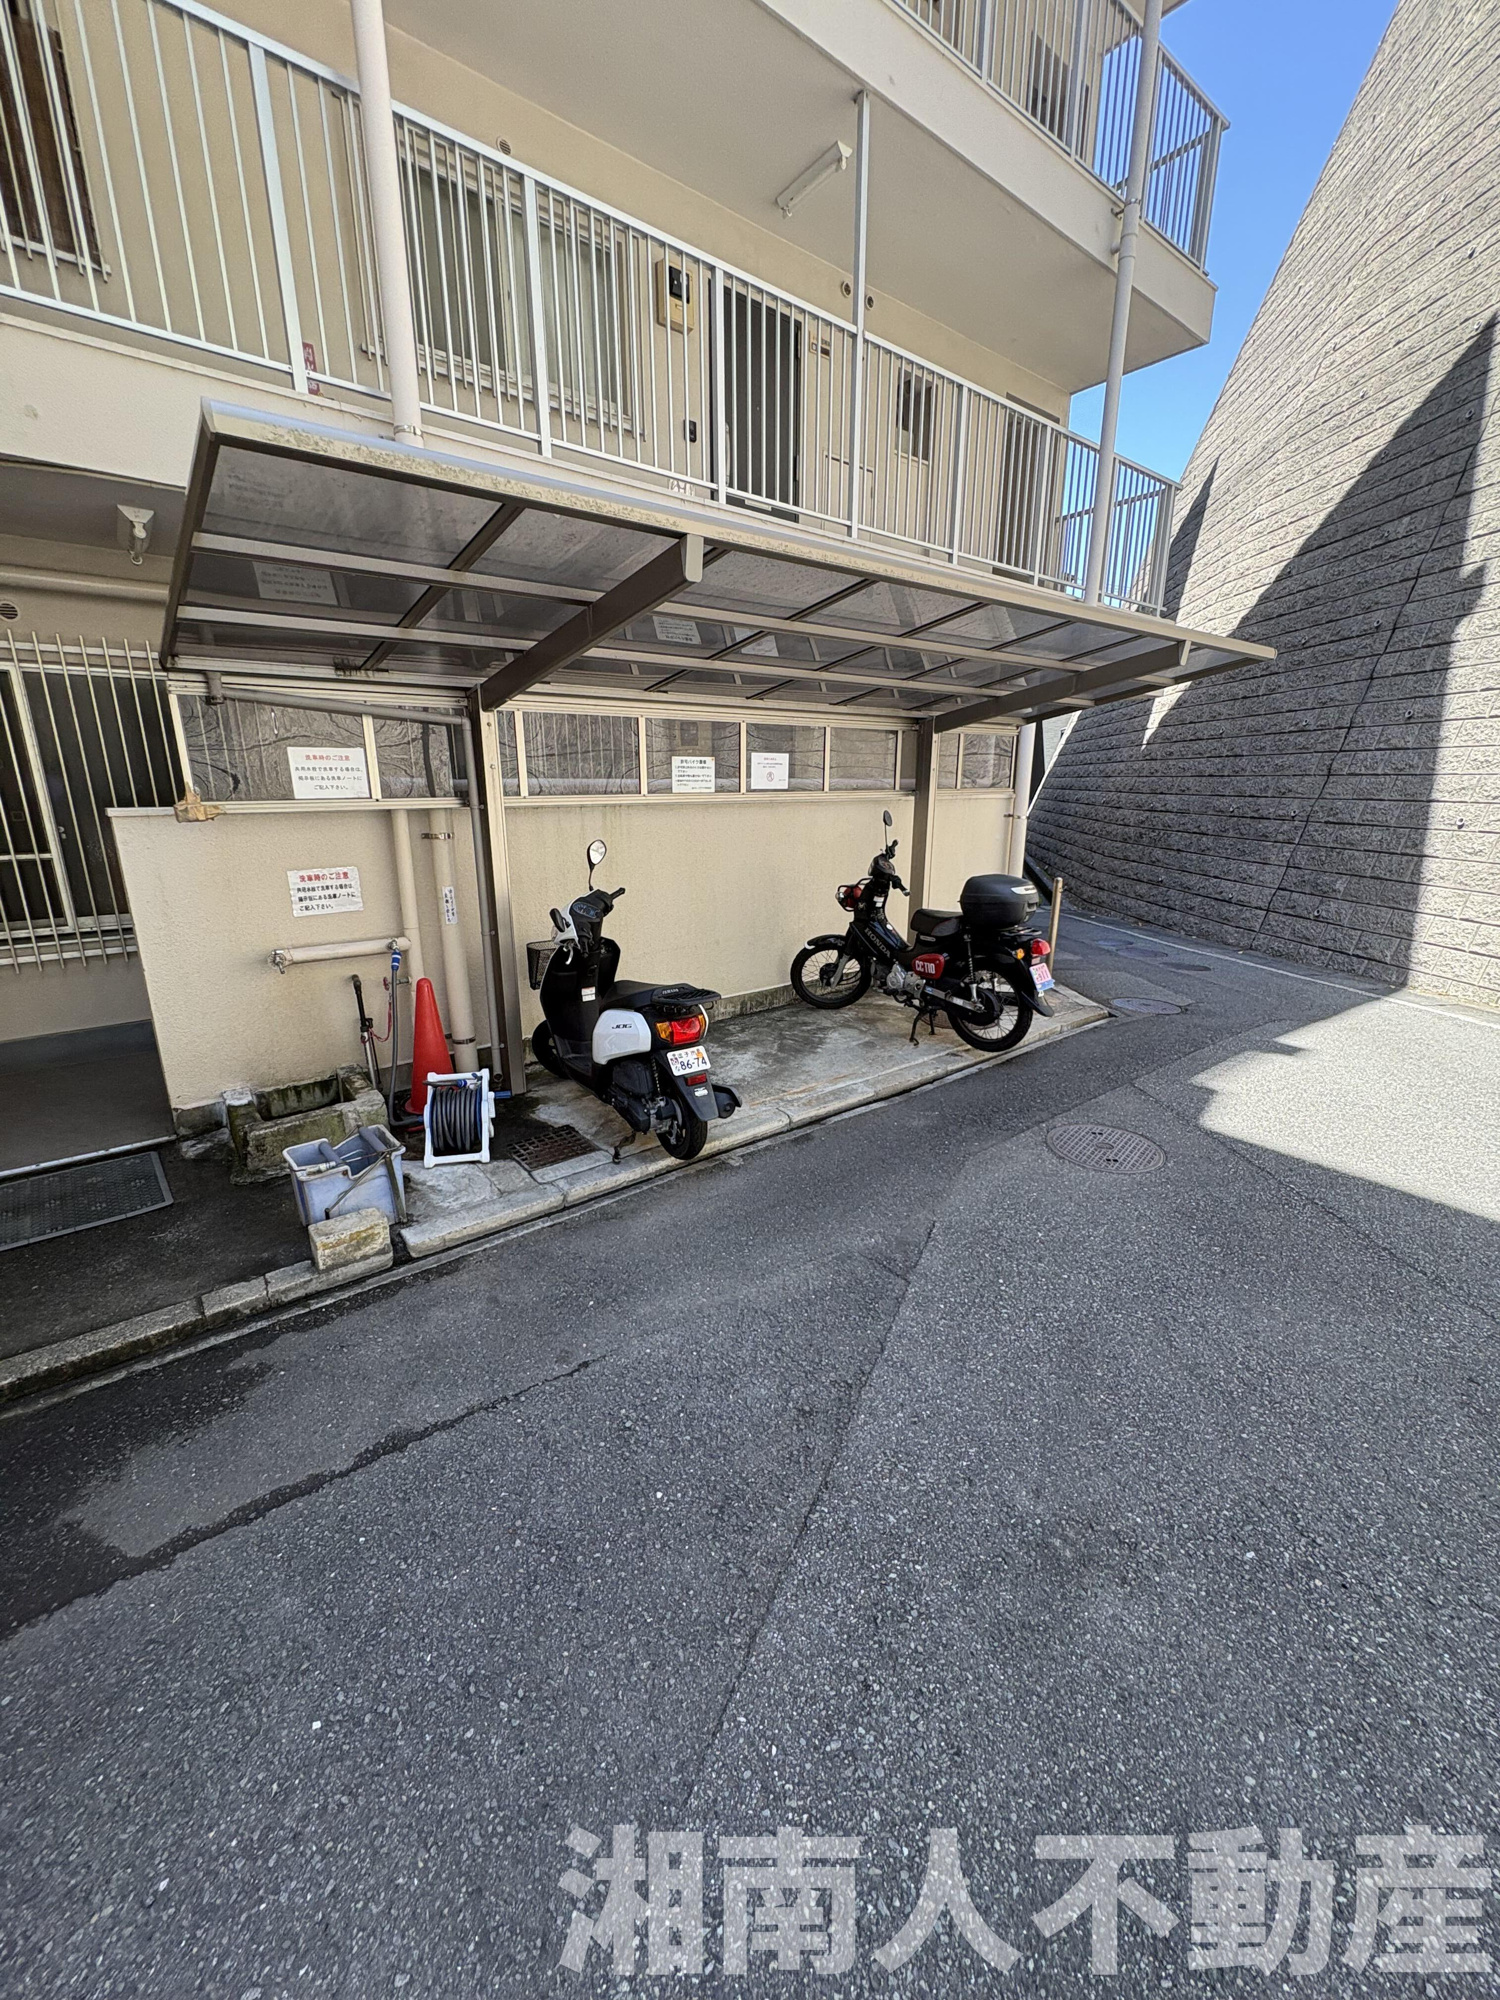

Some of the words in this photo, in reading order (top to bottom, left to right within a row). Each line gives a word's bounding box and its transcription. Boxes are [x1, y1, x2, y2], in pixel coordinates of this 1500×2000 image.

[298, 872, 350, 883] 洗車時のご注意
[864, 927, 891, 959] HONDA
[679, 1056, 708, 1071] 86-74
